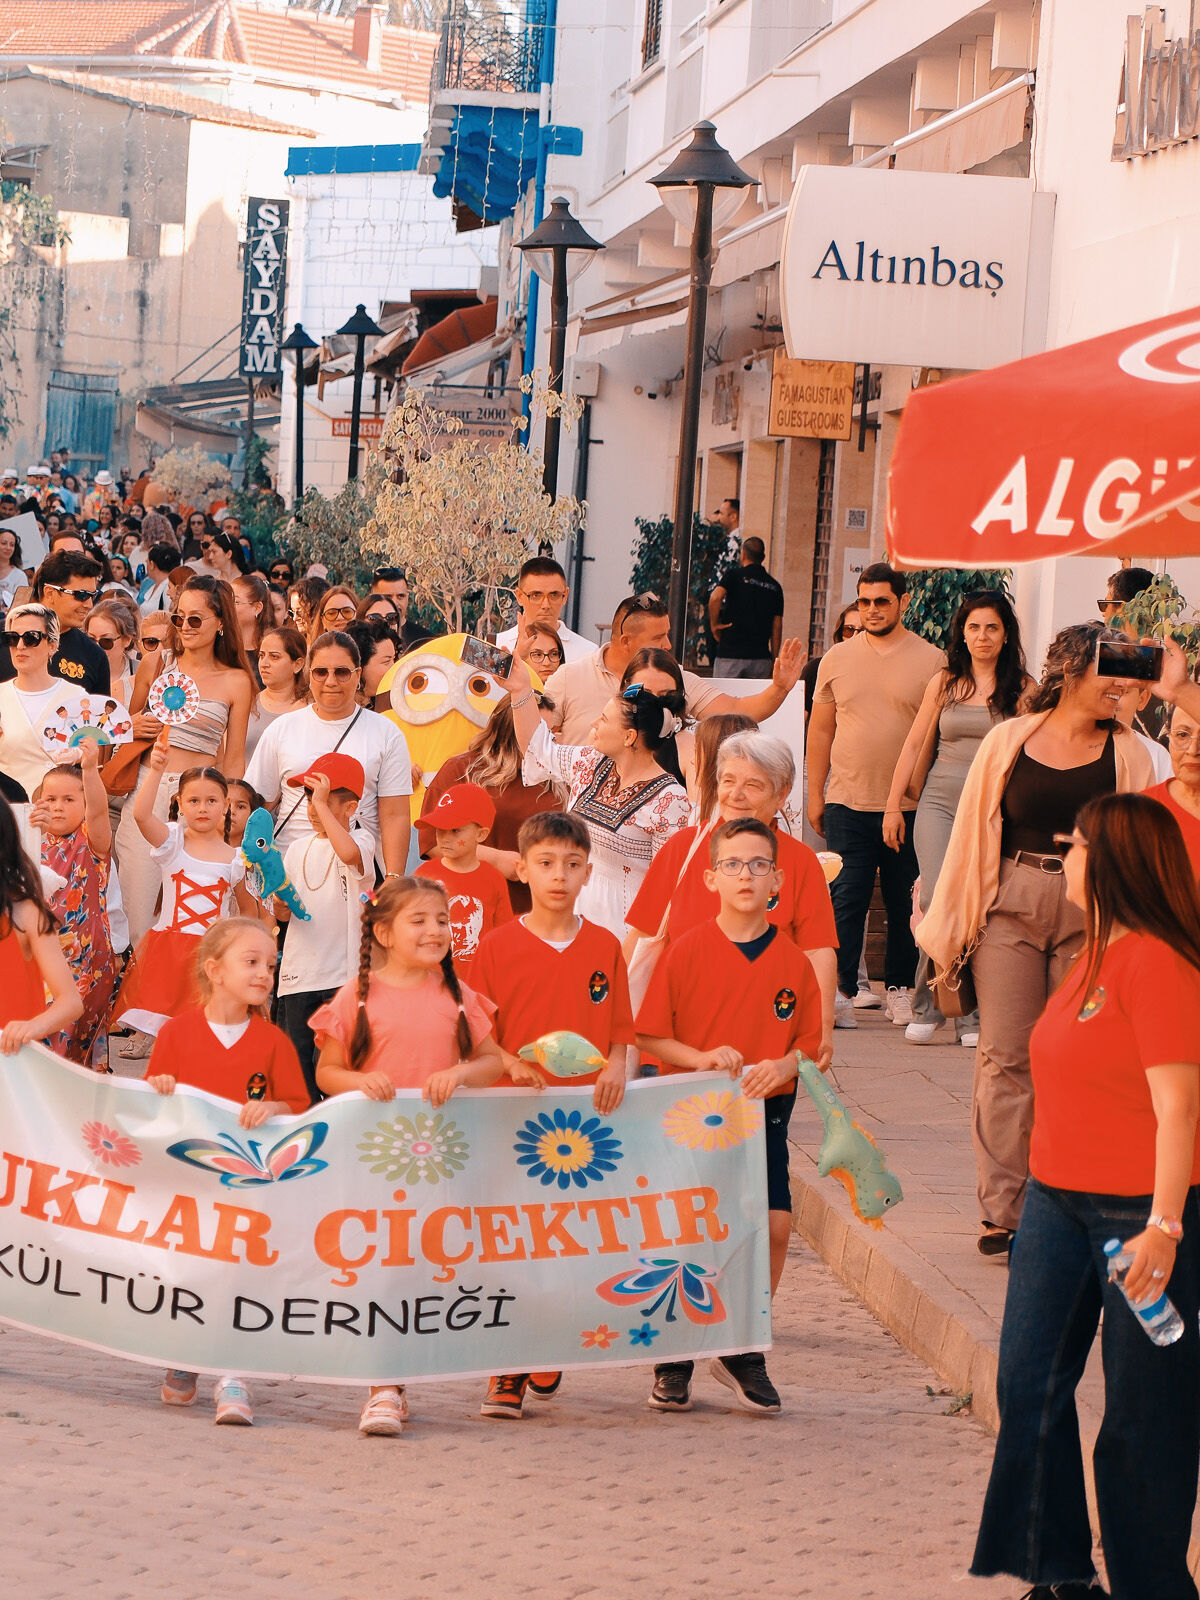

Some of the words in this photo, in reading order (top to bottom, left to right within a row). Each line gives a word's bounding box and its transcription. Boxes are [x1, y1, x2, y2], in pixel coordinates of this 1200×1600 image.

[811, 239, 1004, 298] Altınbaş
[244, 203, 282, 373] SAYDAM
[780, 384, 846, 405] FAMAGUSTIAN
[477, 407, 507, 420] 2000
[777, 409, 809, 428] GUEST
[810, 411, 845, 431] ROOMS
[478, 428, 505, 438] GOLD
[313, 1174, 730, 1288] ÇİÇEKTİR
[232, 1285, 516, 1338] DERNEĞİ
